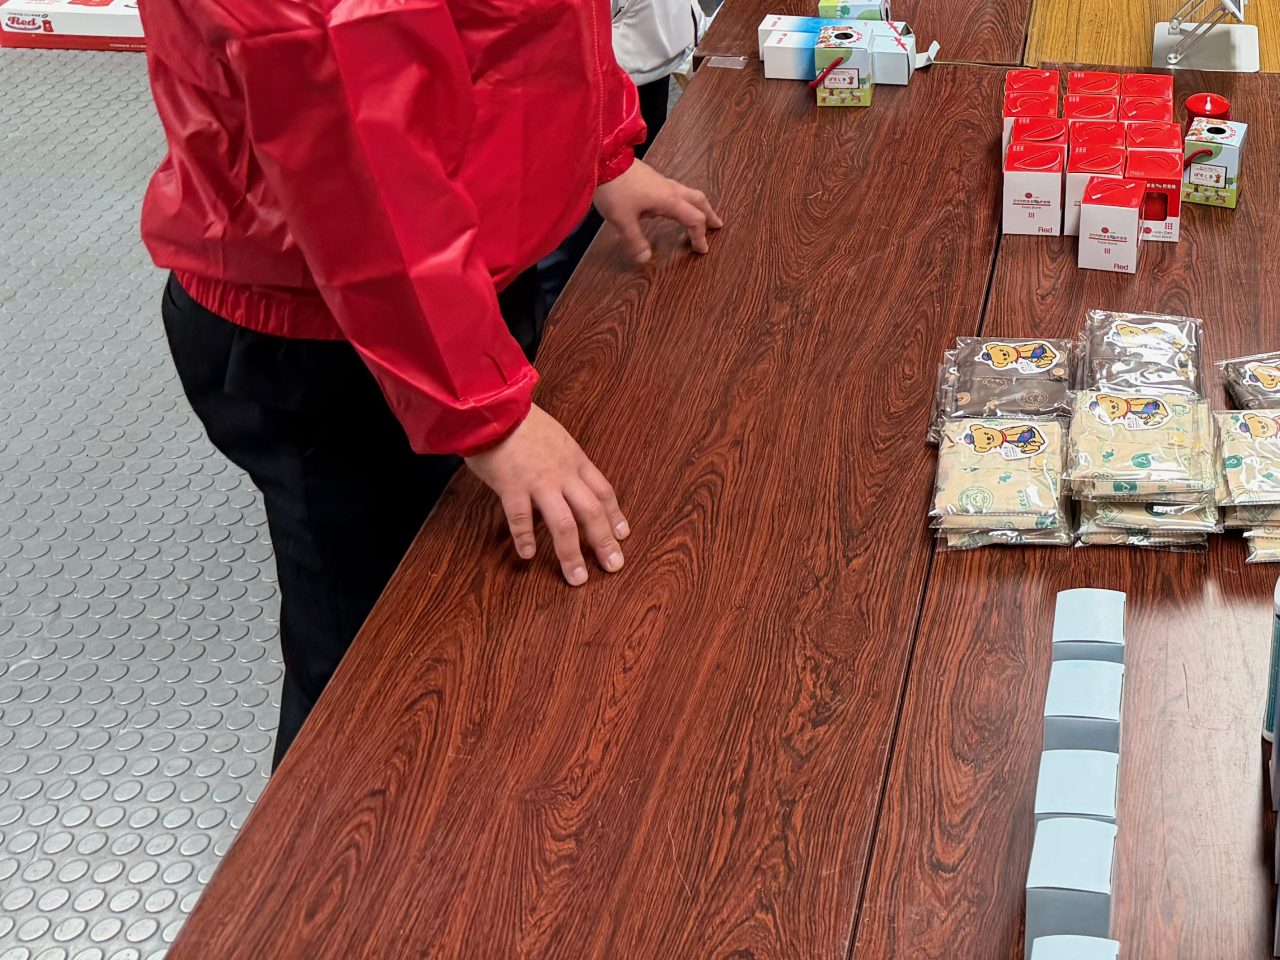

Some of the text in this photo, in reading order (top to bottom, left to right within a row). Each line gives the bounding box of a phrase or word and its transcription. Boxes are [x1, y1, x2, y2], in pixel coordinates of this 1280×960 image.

[7, 16, 37, 27] Red
[1037, 226, 1053, 234] Red
[1113, 263, 1129, 271] Red
